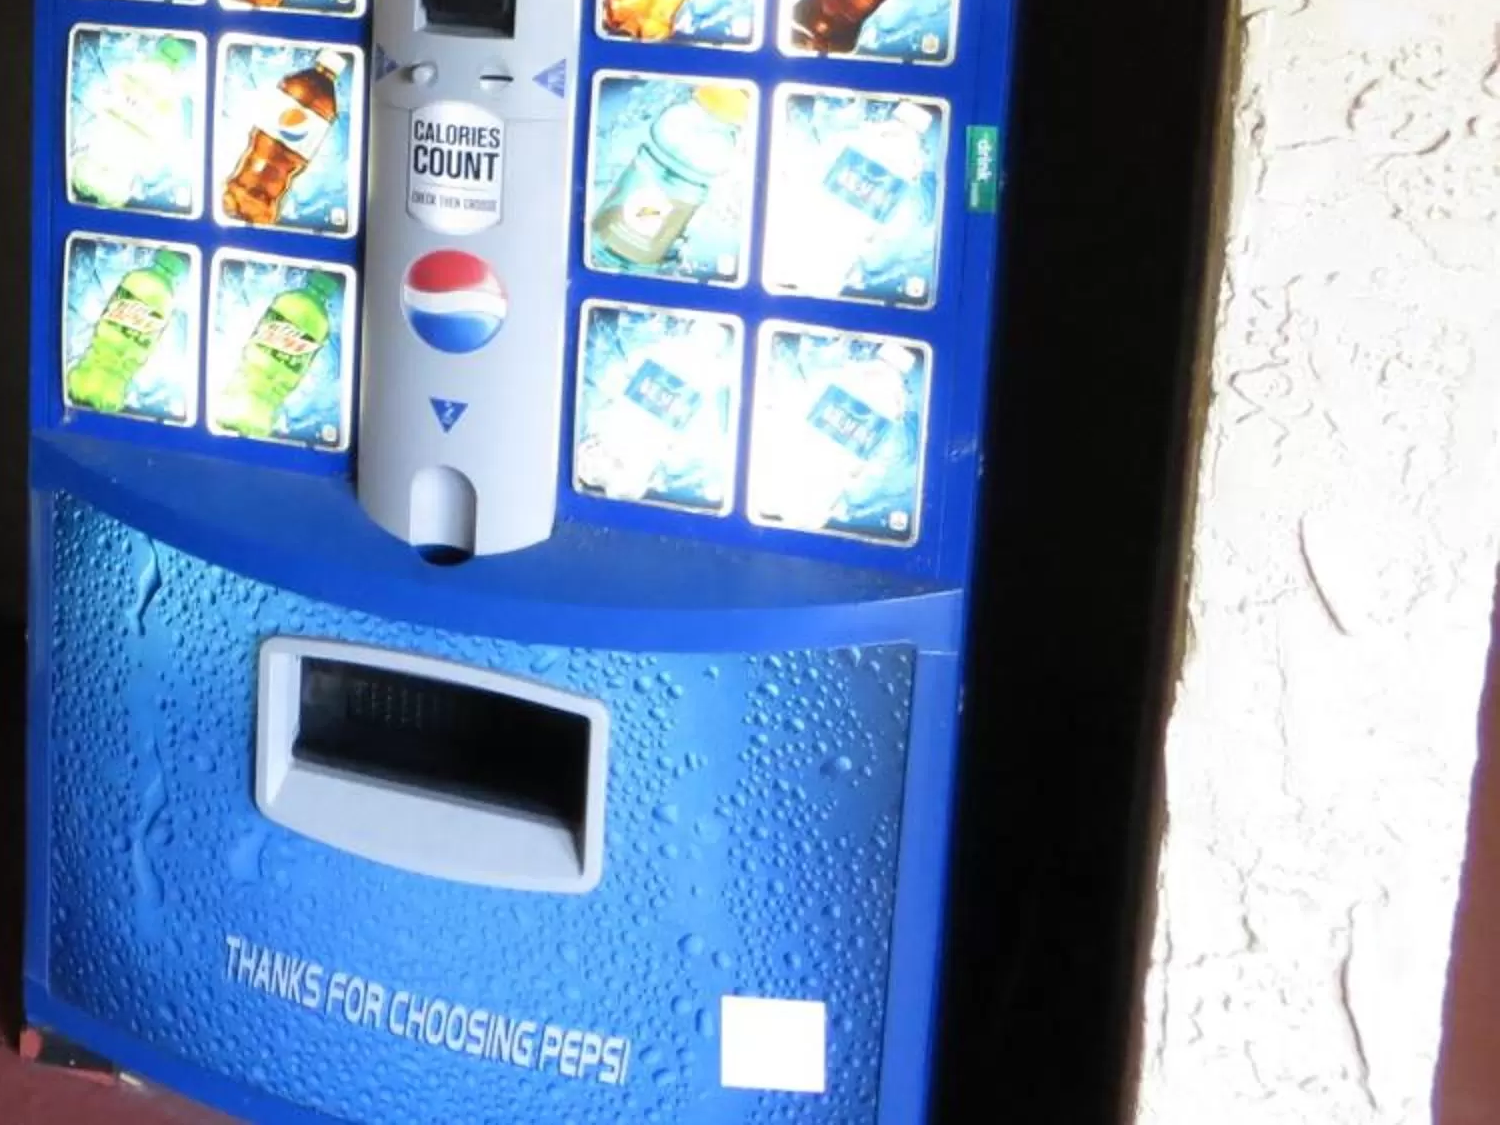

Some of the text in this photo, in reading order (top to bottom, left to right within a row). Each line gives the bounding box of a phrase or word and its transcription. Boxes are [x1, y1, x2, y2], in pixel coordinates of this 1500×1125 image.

[413, 119, 501, 149] CALORIES
[413, 145, 501, 182] COUNT
[225, 935, 632, 1087] THANKS FOR CHOOSING PEPSI
